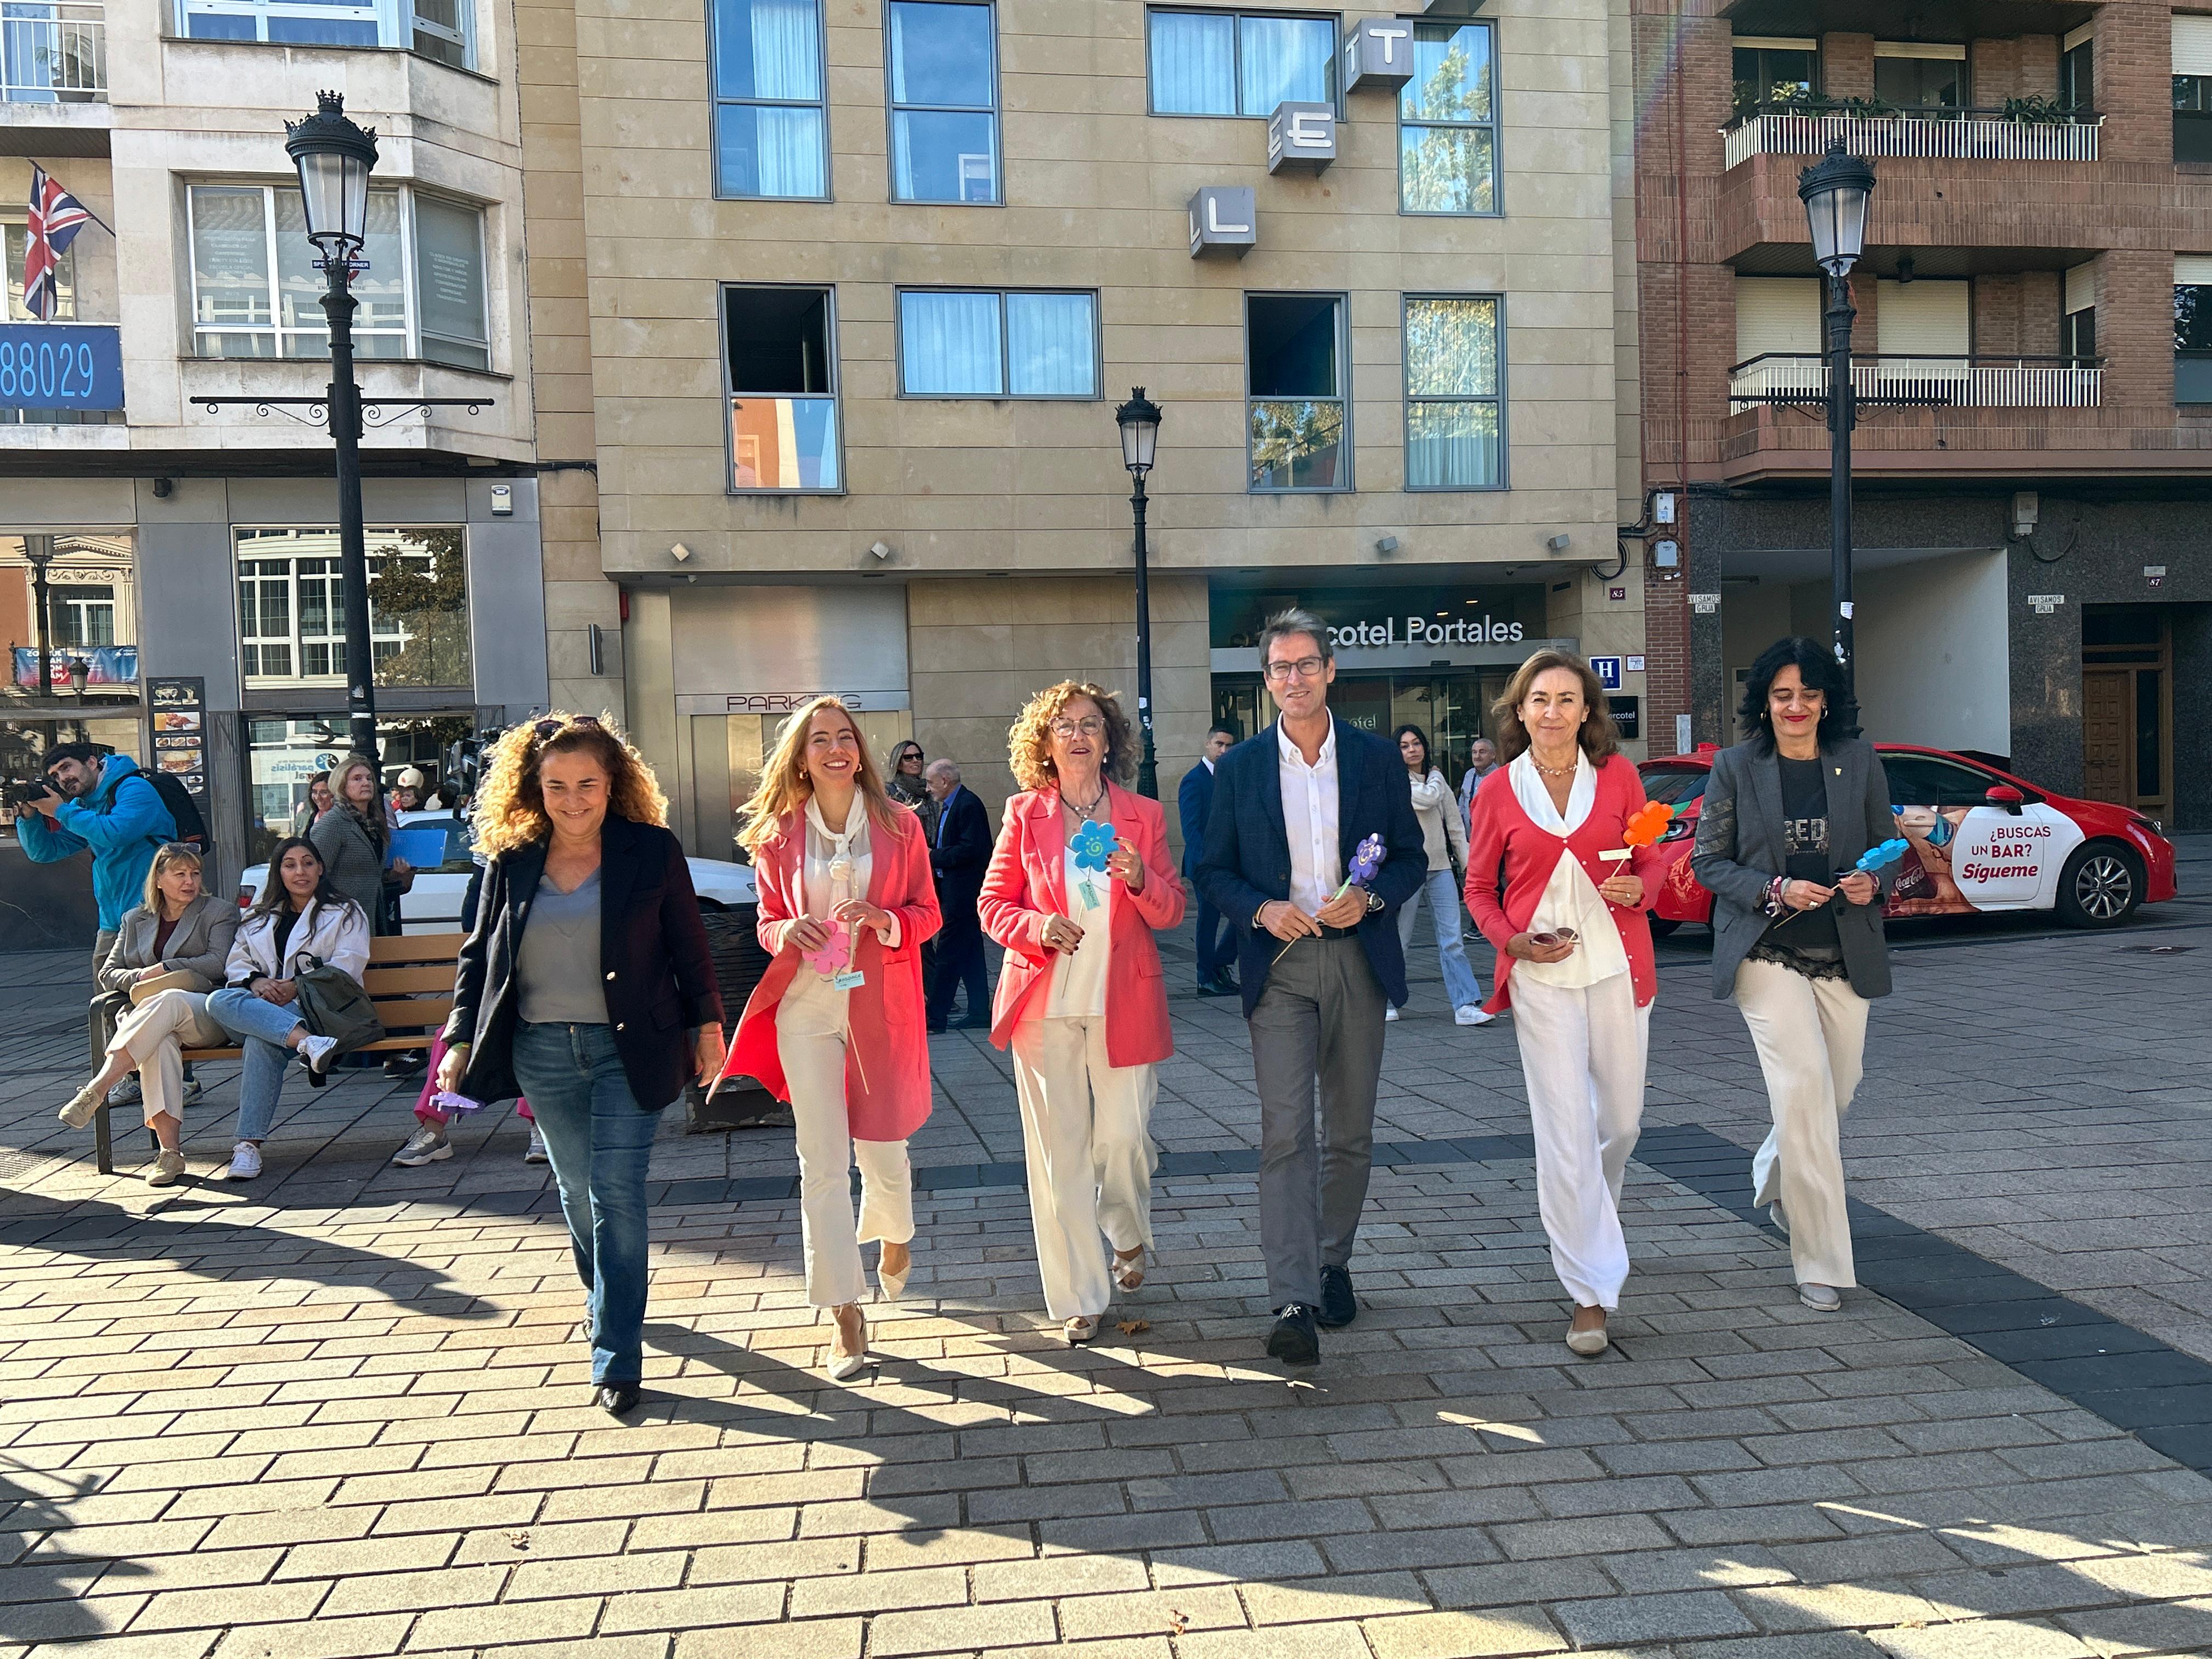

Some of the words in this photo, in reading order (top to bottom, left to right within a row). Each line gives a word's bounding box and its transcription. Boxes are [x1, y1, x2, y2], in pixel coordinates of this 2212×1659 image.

[1368, 28, 1408, 65] T
[1286, 111, 1333, 148] E
[1208, 196, 1250, 233] L
[1, 341, 94, 398] 88029
[1611, 590, 1623, 599] 85
[1327, 617, 1393, 646] cotel
[1407, 614, 1523, 644] Portales
[1597, 661, 1614, 678] H
[726, 693, 862, 712] PARKG
[1990, 826, 2051, 842] ¿BUSCAS
[1971, 845, 1988, 856] UN
[1991, 843, 2033, 858] BAR?
[1962, 863, 2038, 884] Sígueme
